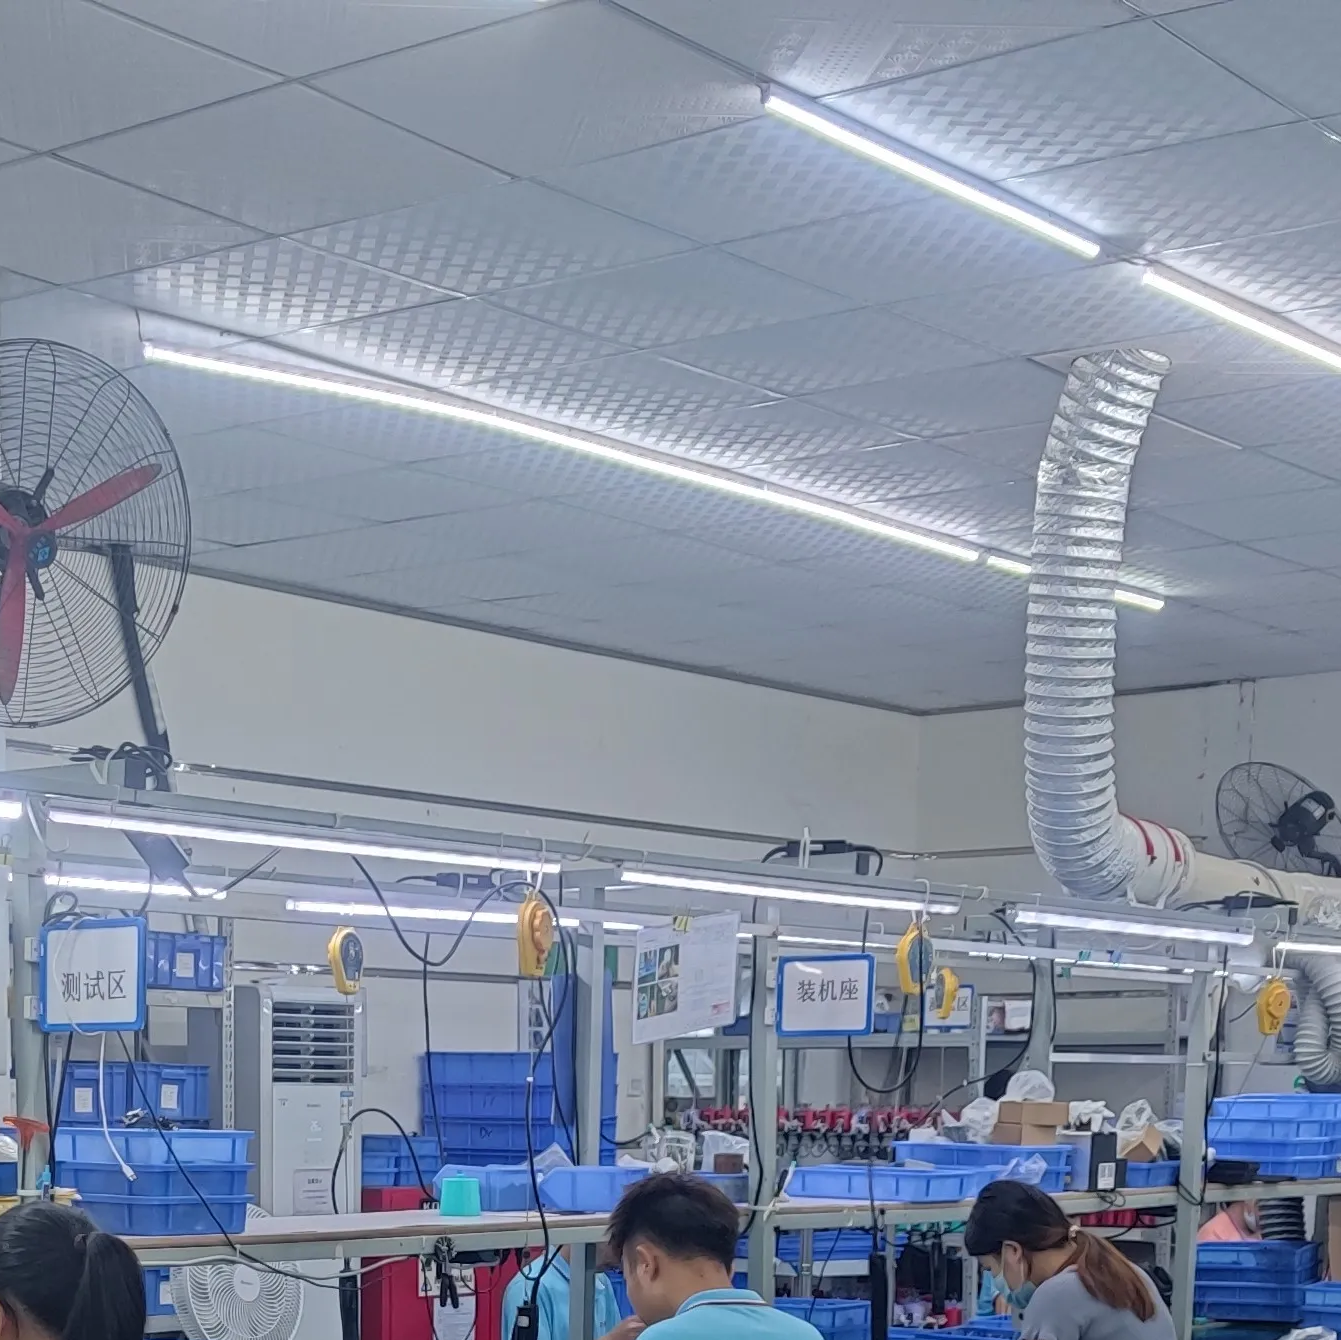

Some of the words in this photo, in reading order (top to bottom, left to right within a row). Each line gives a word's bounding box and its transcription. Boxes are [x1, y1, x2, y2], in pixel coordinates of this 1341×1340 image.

[61, 968, 126, 1002] 测试区
[796, 977, 859, 1003] 装机座
